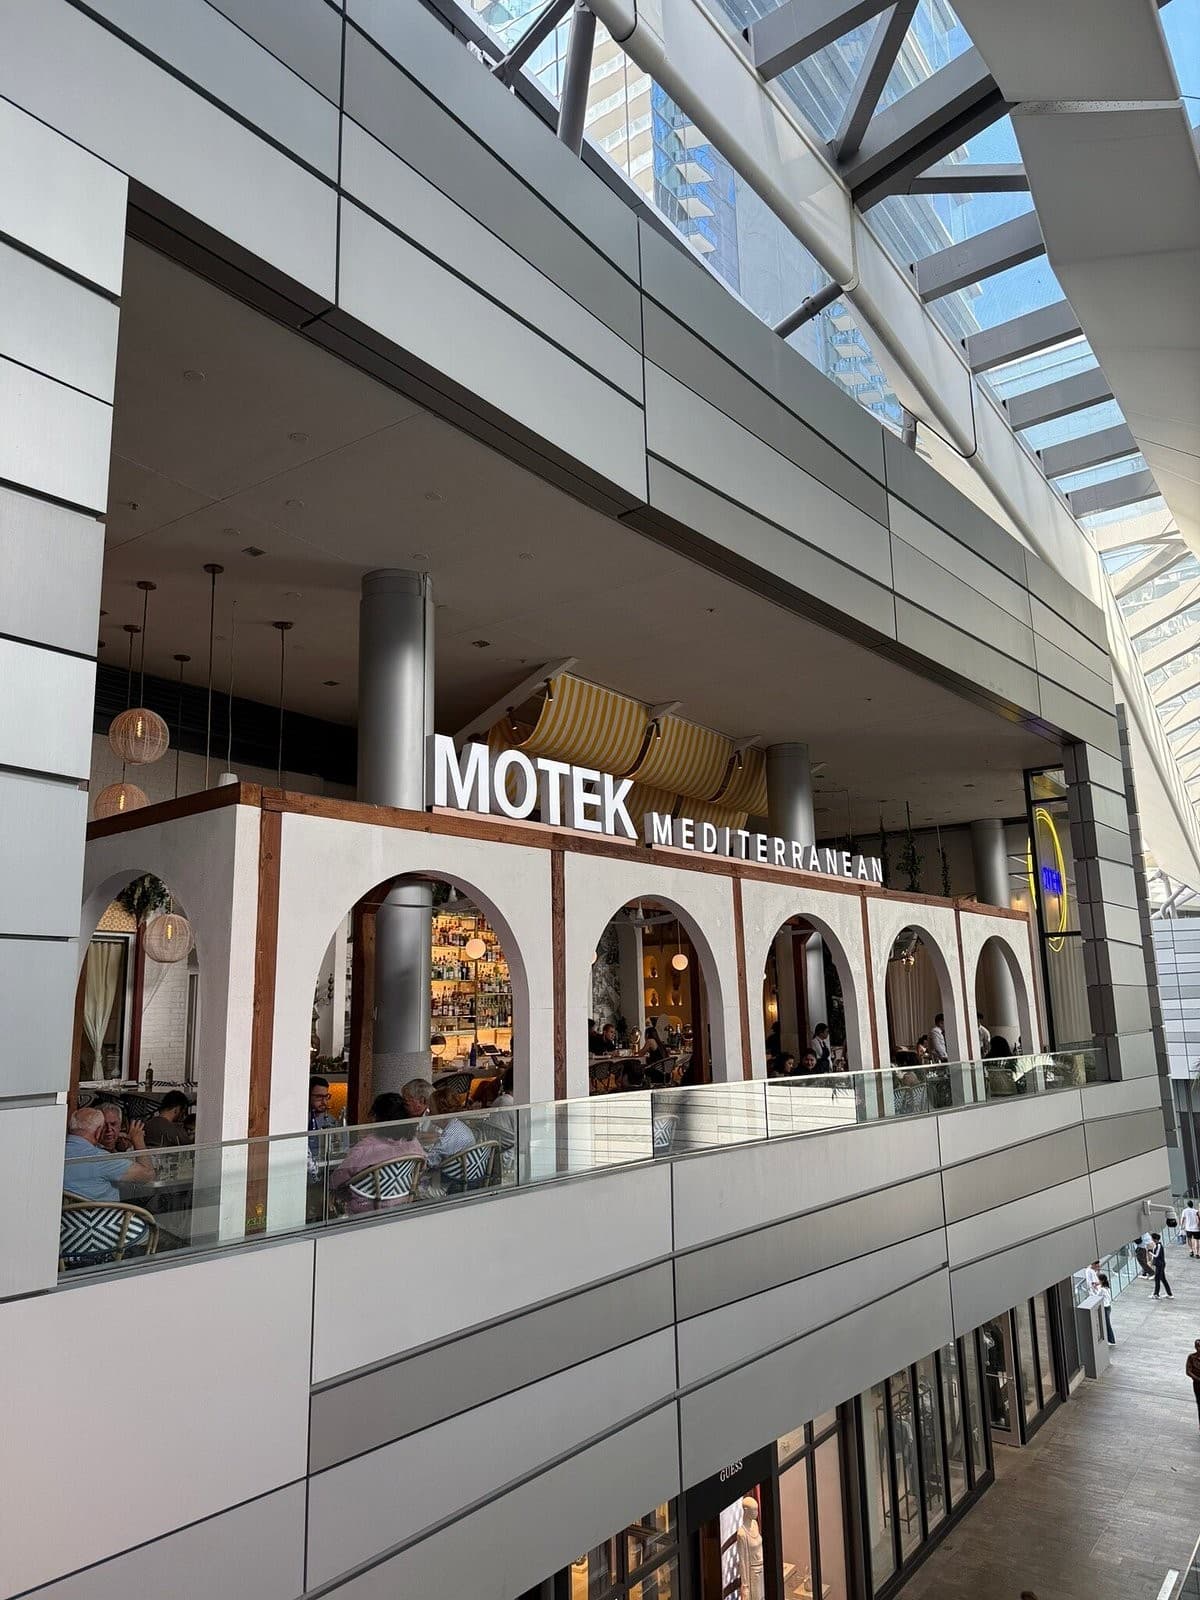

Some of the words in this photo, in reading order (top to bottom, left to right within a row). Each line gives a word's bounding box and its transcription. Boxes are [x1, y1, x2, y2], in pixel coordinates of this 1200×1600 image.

[433, 733, 639, 840] MOTEK
[651, 811, 884, 883] MEDITERRANEAN
[720, 1459, 744, 1482] GUESS
